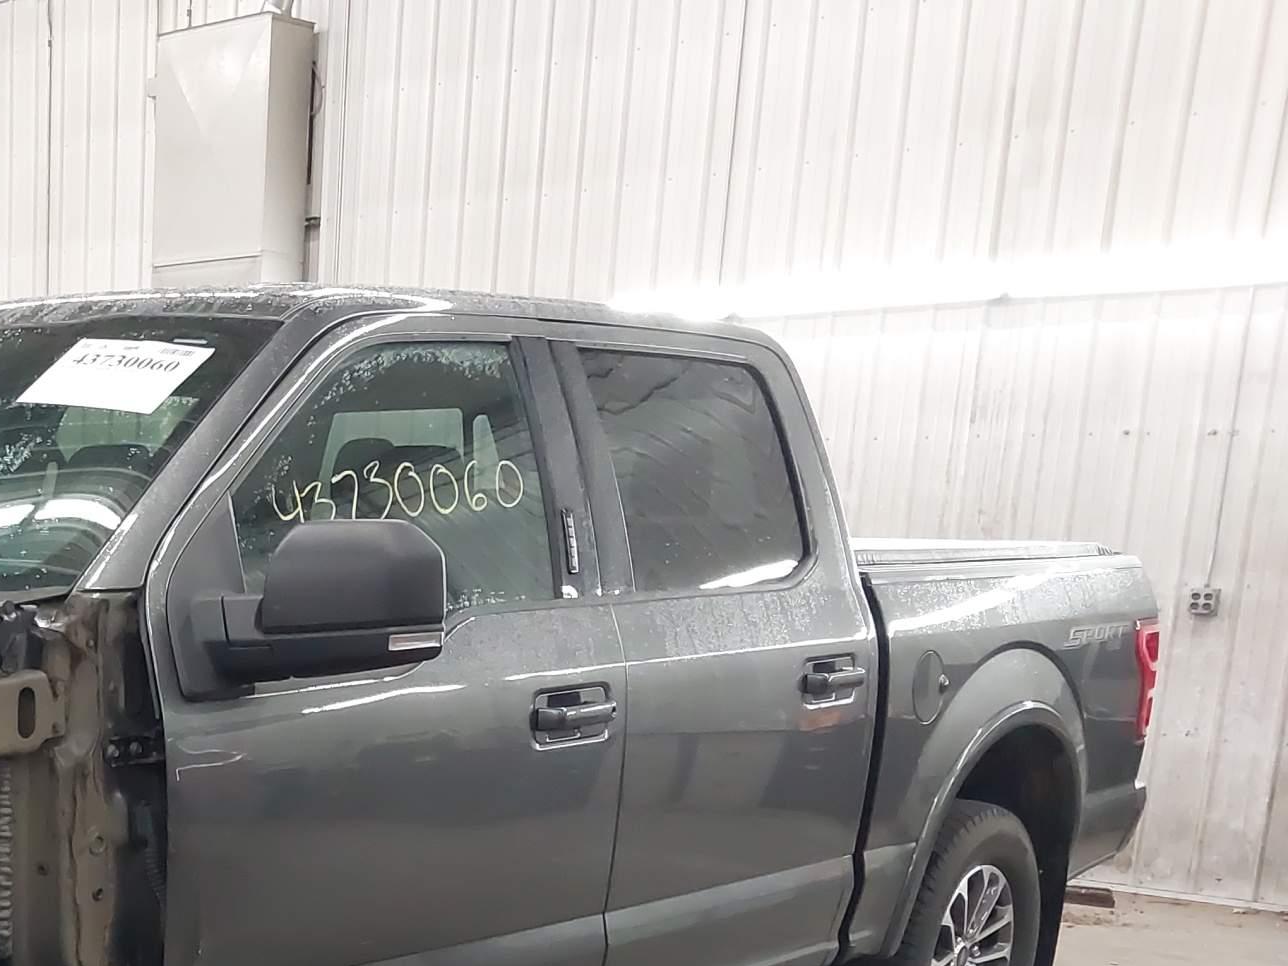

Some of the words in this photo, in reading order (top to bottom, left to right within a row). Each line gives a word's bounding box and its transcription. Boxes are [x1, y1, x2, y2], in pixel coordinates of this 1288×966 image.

[72, 353, 181, 373] 43730060
[271, 459, 524, 524] 43730060
[1062, 623, 1130, 650] SPORT
